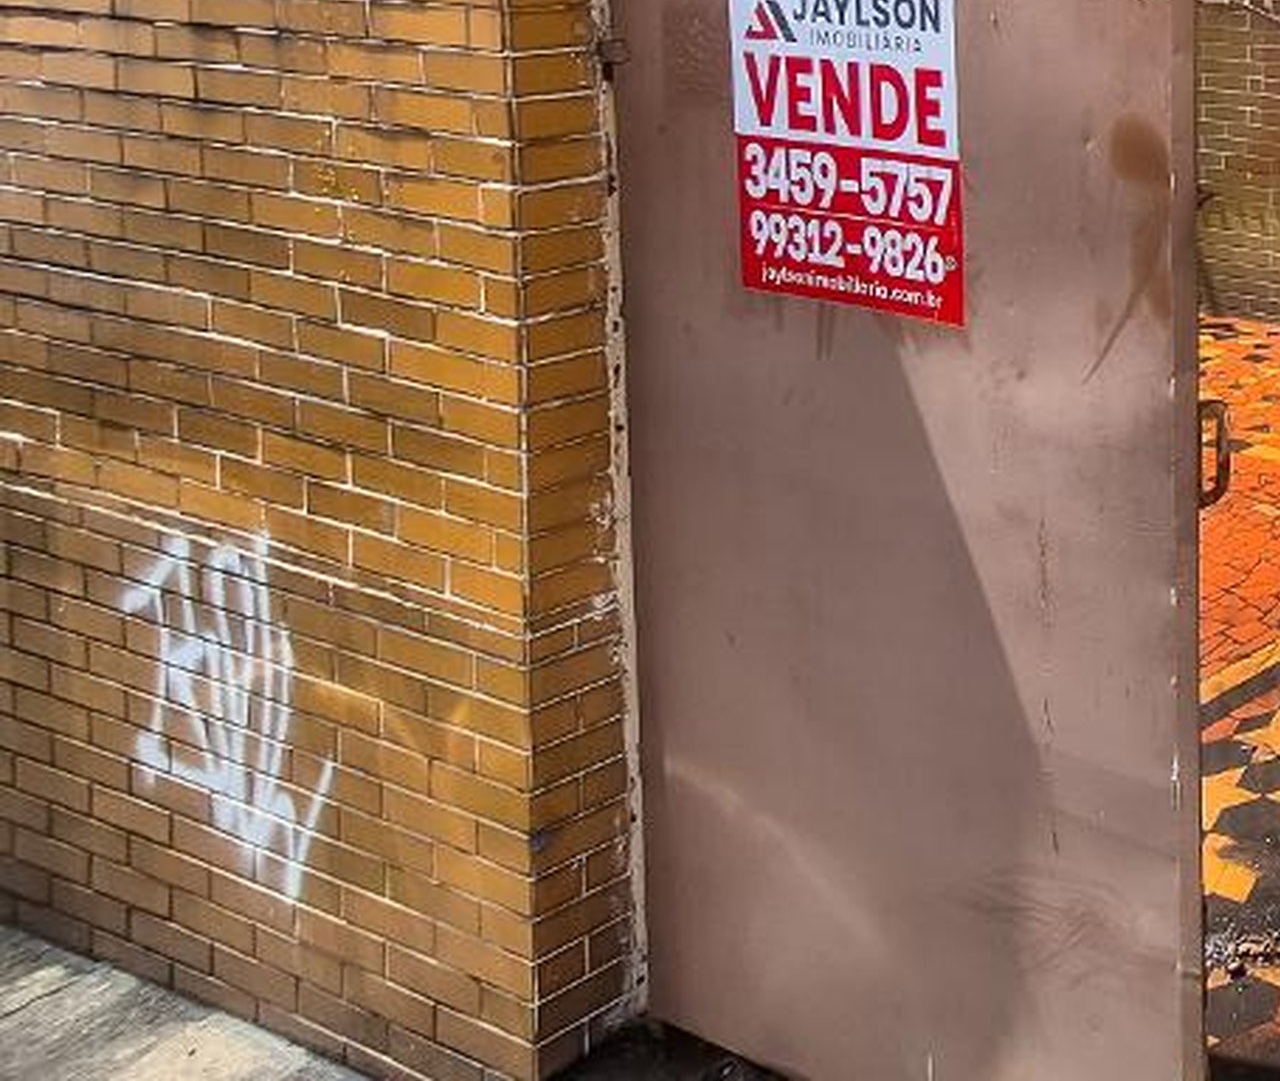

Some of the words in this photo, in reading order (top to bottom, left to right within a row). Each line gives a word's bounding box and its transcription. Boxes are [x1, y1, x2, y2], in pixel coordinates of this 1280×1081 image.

[743, 51, 947, 148] VENDE
[744, 143, 953, 225] 3459-5757
[750, 210, 946, 285] 99312-9826
